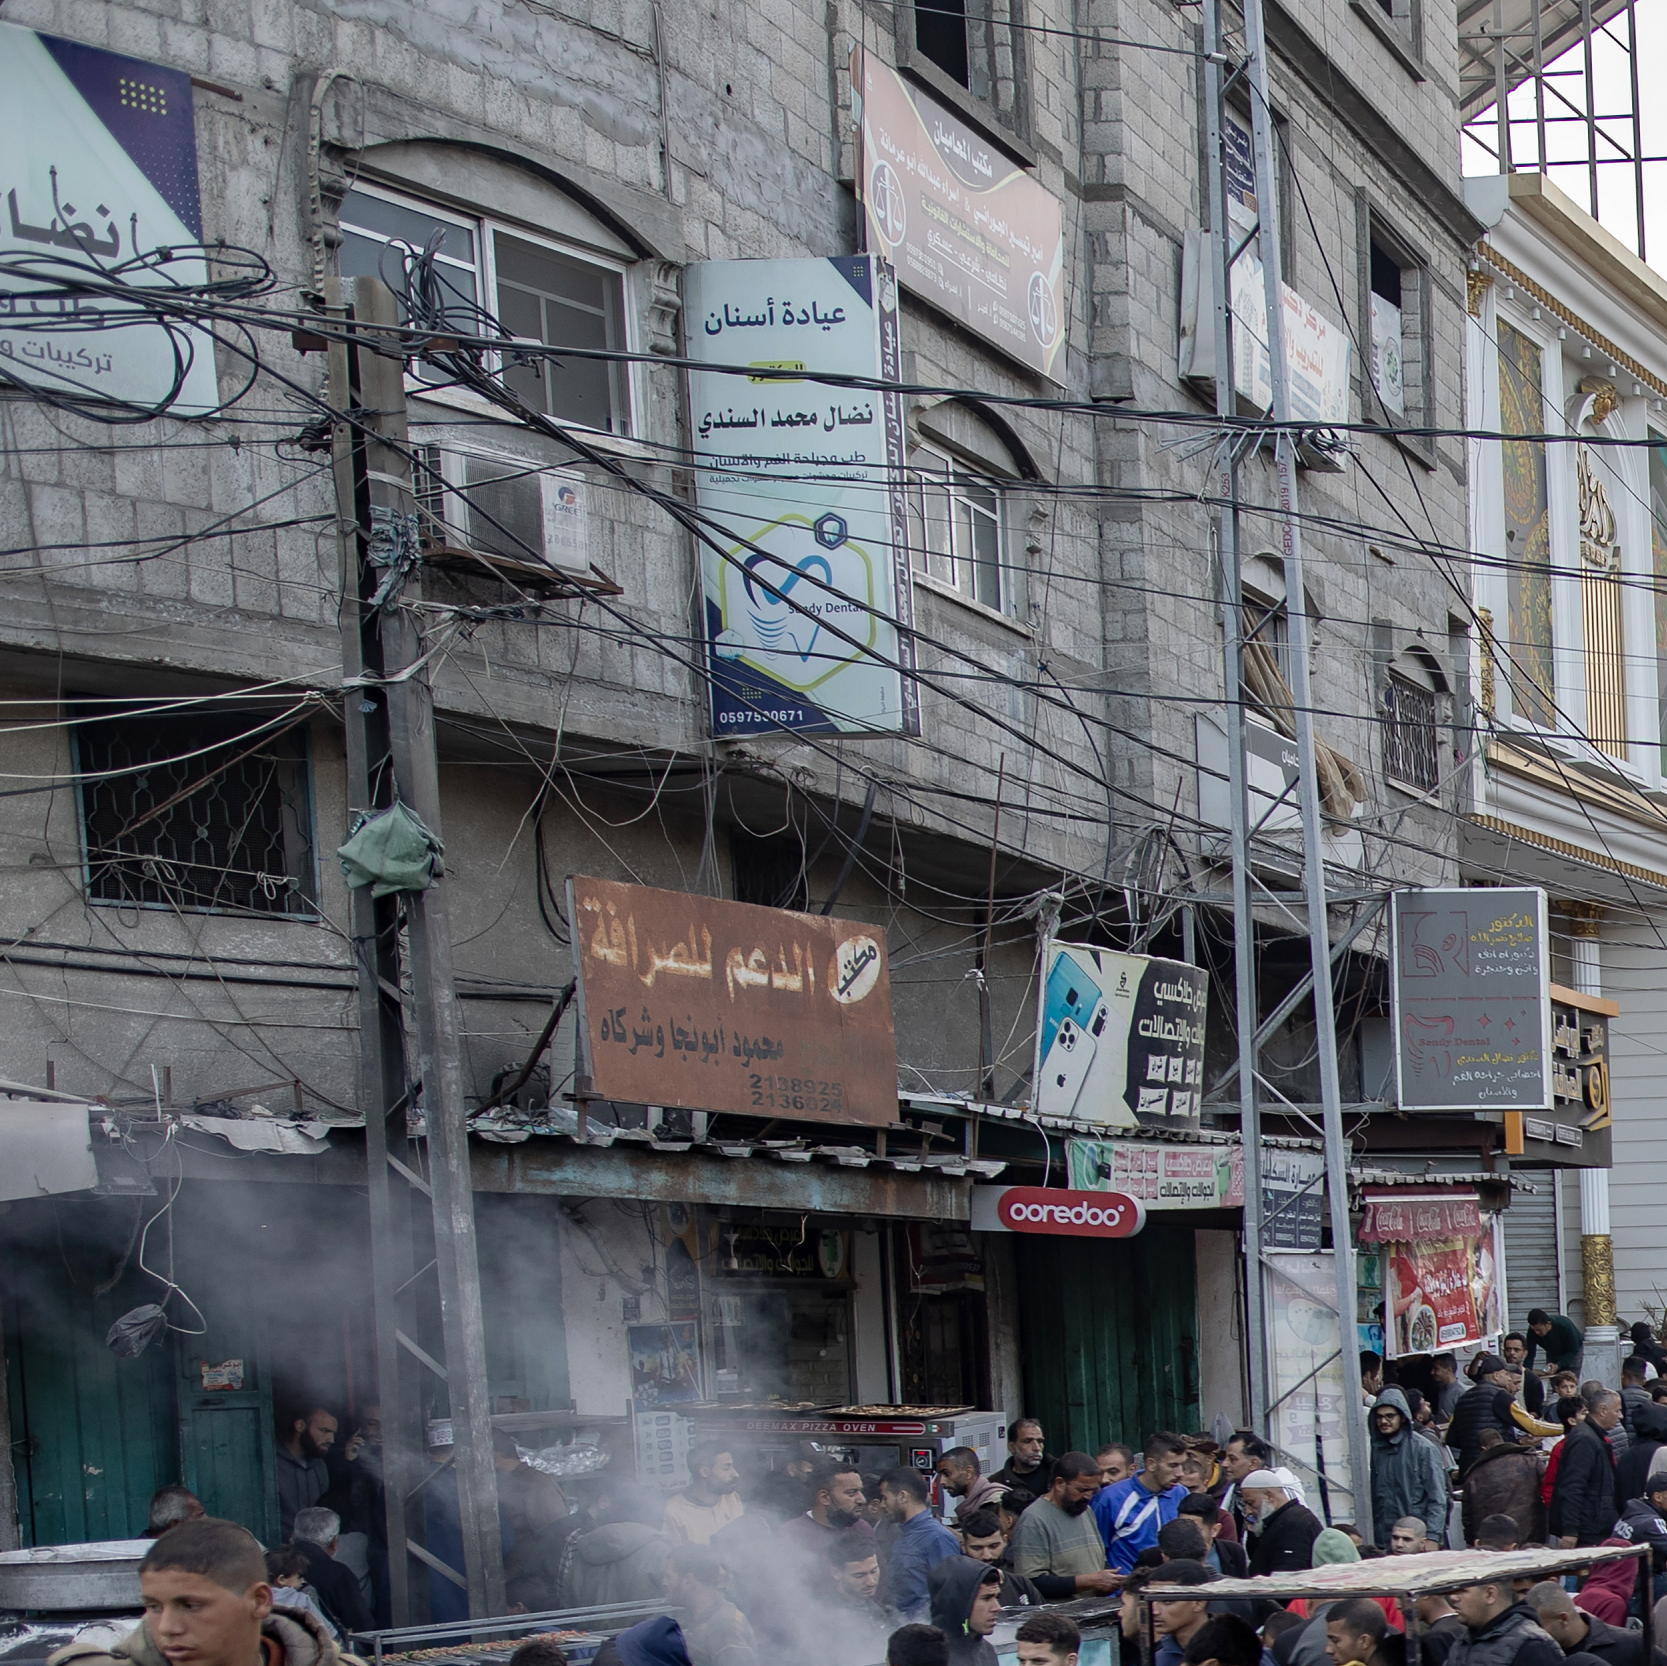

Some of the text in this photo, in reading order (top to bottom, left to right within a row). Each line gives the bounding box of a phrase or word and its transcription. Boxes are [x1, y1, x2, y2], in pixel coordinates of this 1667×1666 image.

[1, 187, 120, 258] نضا
[704, 296, 846, 335] عيادة أسنان
[22, 340, 113, 375] تركيبات
[698, 403, 873, 439] نضال محمد السندي
[1489, 912, 1535, 934] الدكتور
[581, 895, 816, 1004] الدعم للصرافة
[837, 942, 878, 998] مكتب
[600, 1005, 666, 1058] وشركاه
[731, 1028, 785, 1067] محمود
[1009, 1201, 1121, 1227] ooredoo
[802, 1422, 837, 1433] PIZZA
[842, 1422, 877, 1433] OVEN
